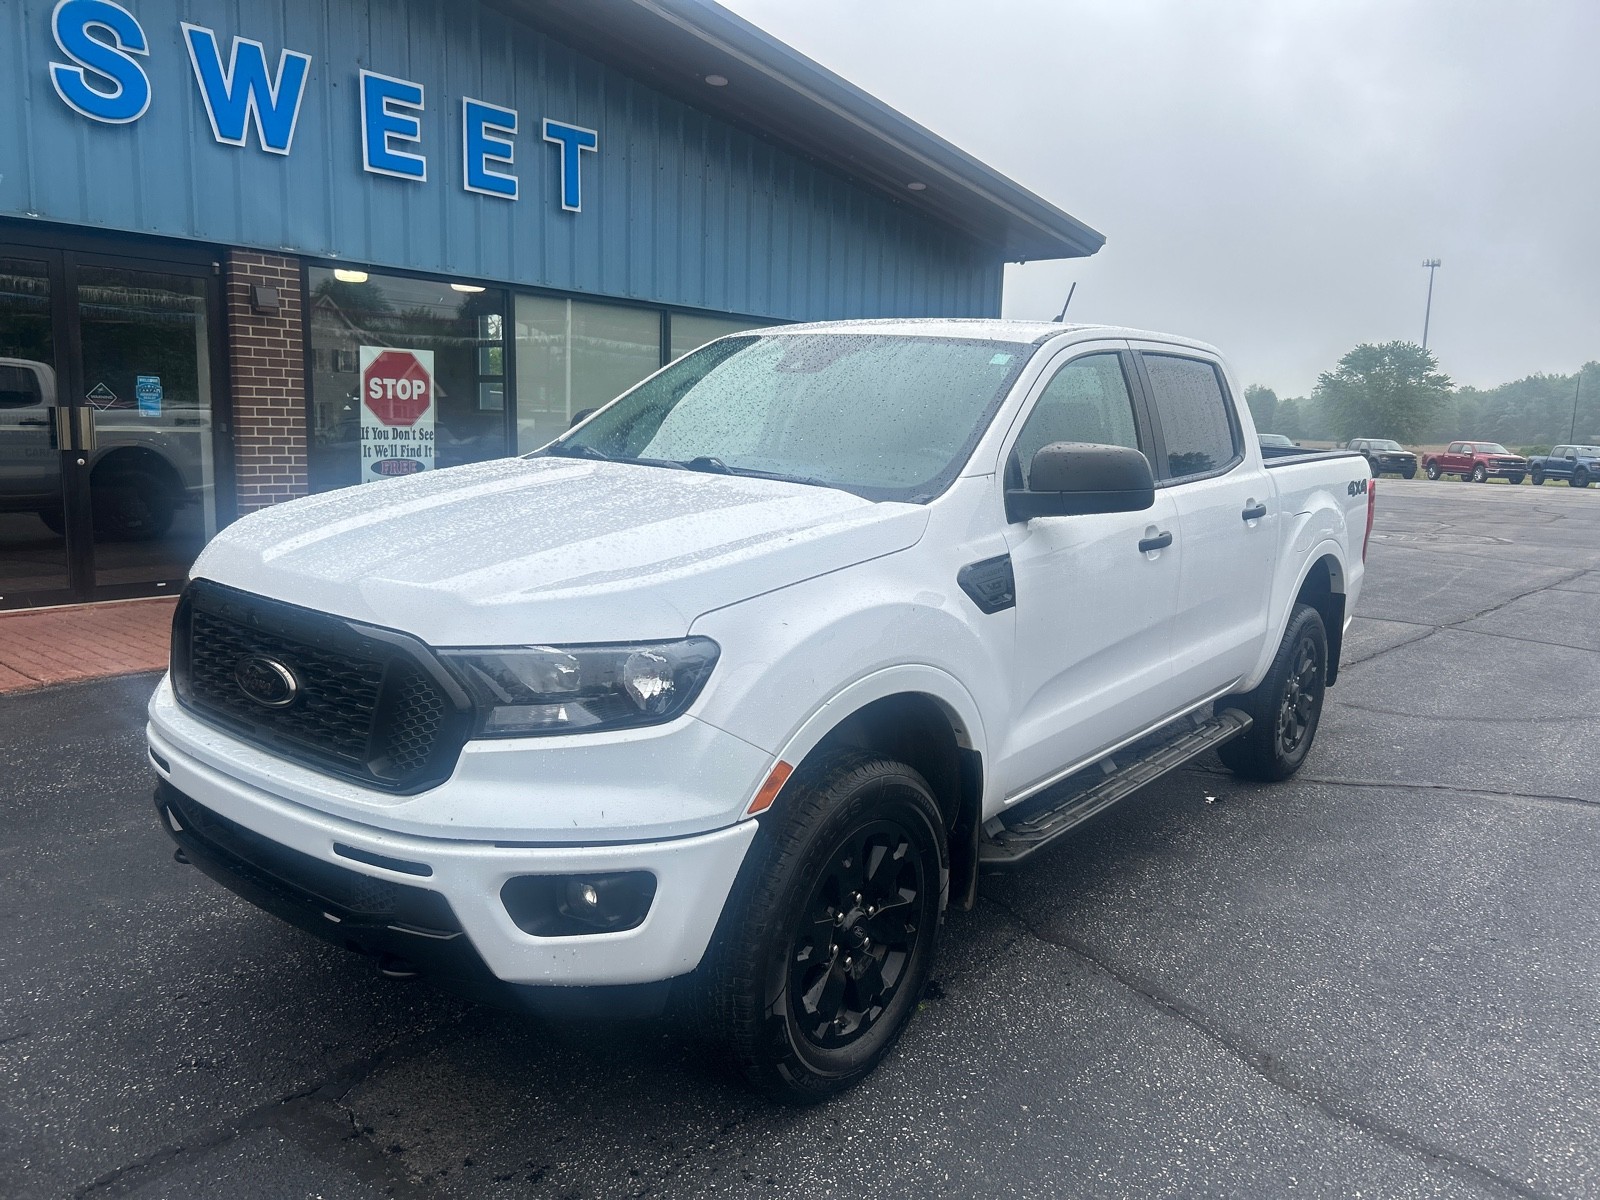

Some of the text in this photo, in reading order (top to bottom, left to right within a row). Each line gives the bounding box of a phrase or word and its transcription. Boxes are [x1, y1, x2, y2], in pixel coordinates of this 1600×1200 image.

[49, 0, 598, 213] SWEET
[369, 377, 426, 400] STOP
[361, 427, 434, 441] If You Don't See
[363, 444, 432, 458] It We'll Find It
[381, 461, 417, 475] FREE
